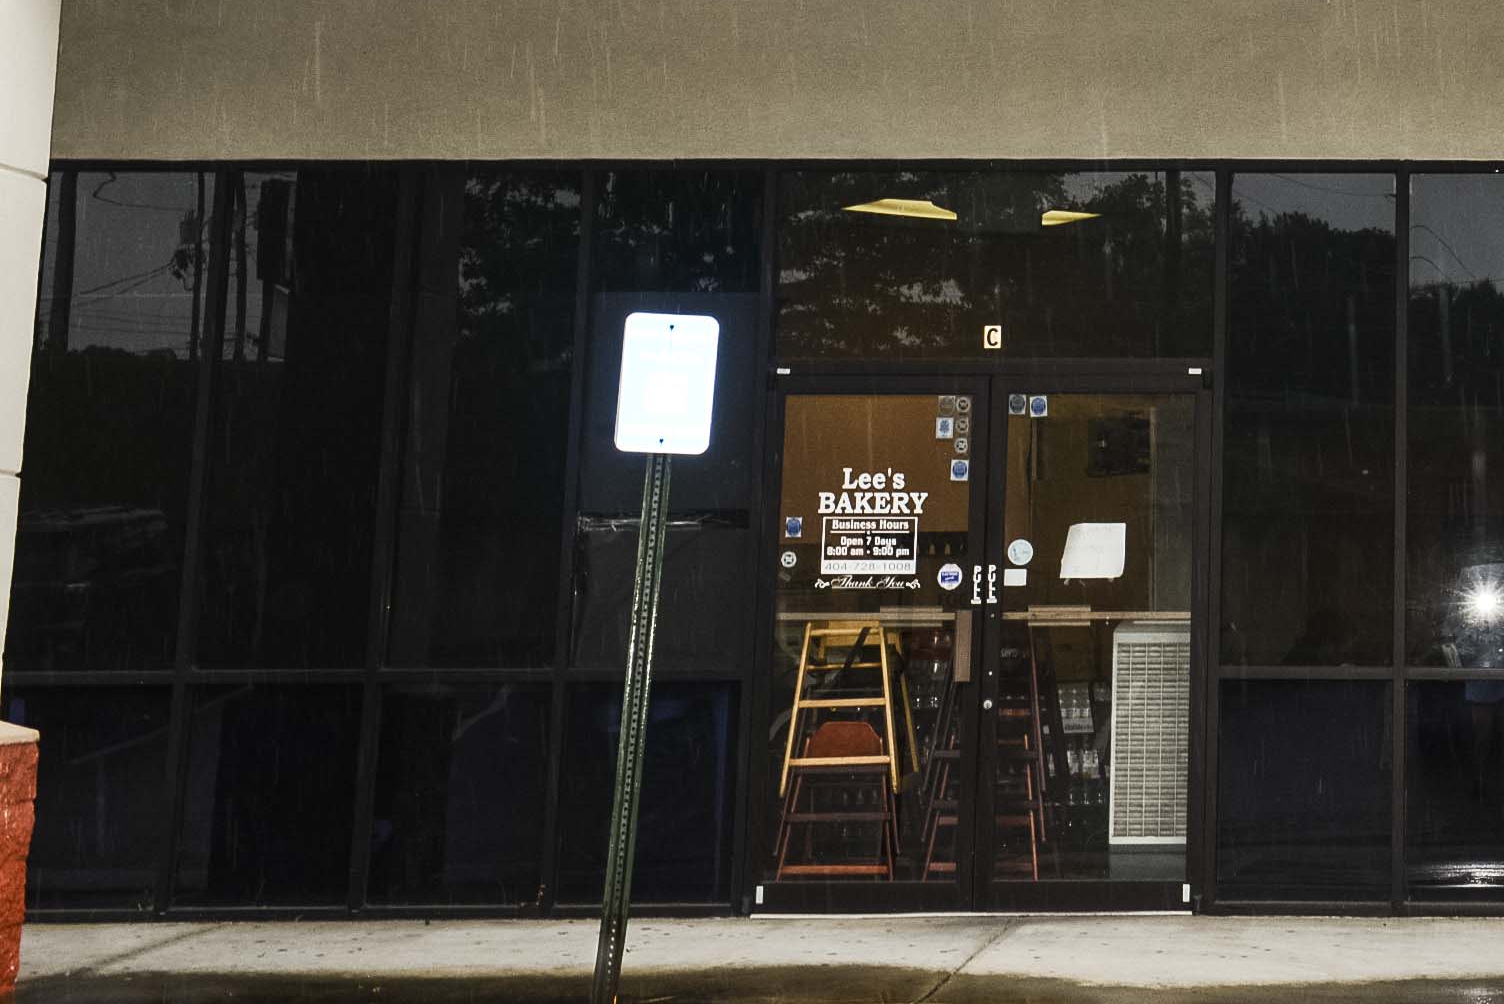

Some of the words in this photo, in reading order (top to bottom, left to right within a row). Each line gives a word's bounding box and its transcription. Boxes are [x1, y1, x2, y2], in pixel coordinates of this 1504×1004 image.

[986, 327, 999, 347] C
[841, 467, 906, 490] Lee's
[817, 491, 929, 514] BAKERY
[831, 519, 877, 530] Business
[879, 519, 909, 530] Hours
[840, 536, 864, 547] Open
[866, 536, 872, 546] 7
[874, 536, 897, 548] Days
[850, 548, 864, 556] am
[872, 546, 894, 556] 9:00
[895, 548, 910, 558] pm
[824, 562, 912, 572] 404-728-1008
[831, 575, 876, 589] Thank
[876, 575, 905, 589] You
